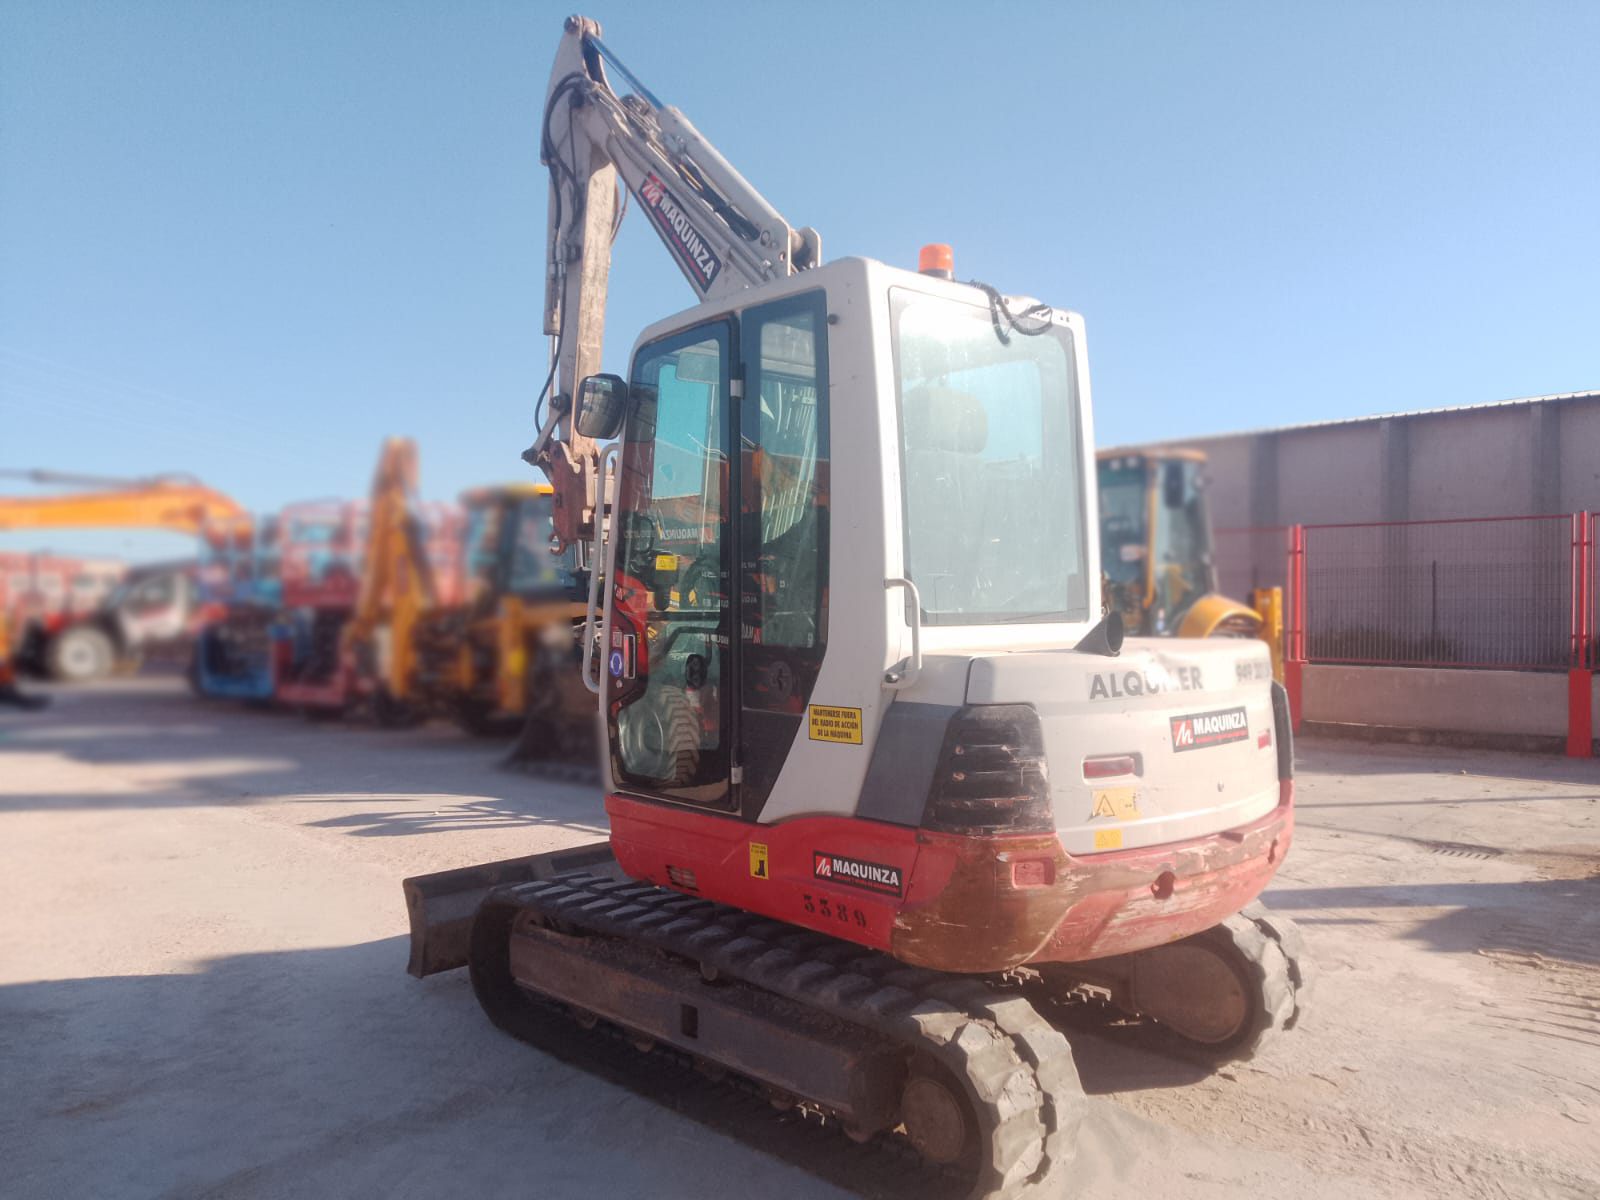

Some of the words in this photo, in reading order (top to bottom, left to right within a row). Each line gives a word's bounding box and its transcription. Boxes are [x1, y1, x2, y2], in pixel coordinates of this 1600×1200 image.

[659, 192, 715, 280] MAQUINZA
[1089, 664, 1204, 701] ALQUER
[1193, 712, 1247, 735] MAQUINZA
[832, 858, 899, 887] MAQUINZA
